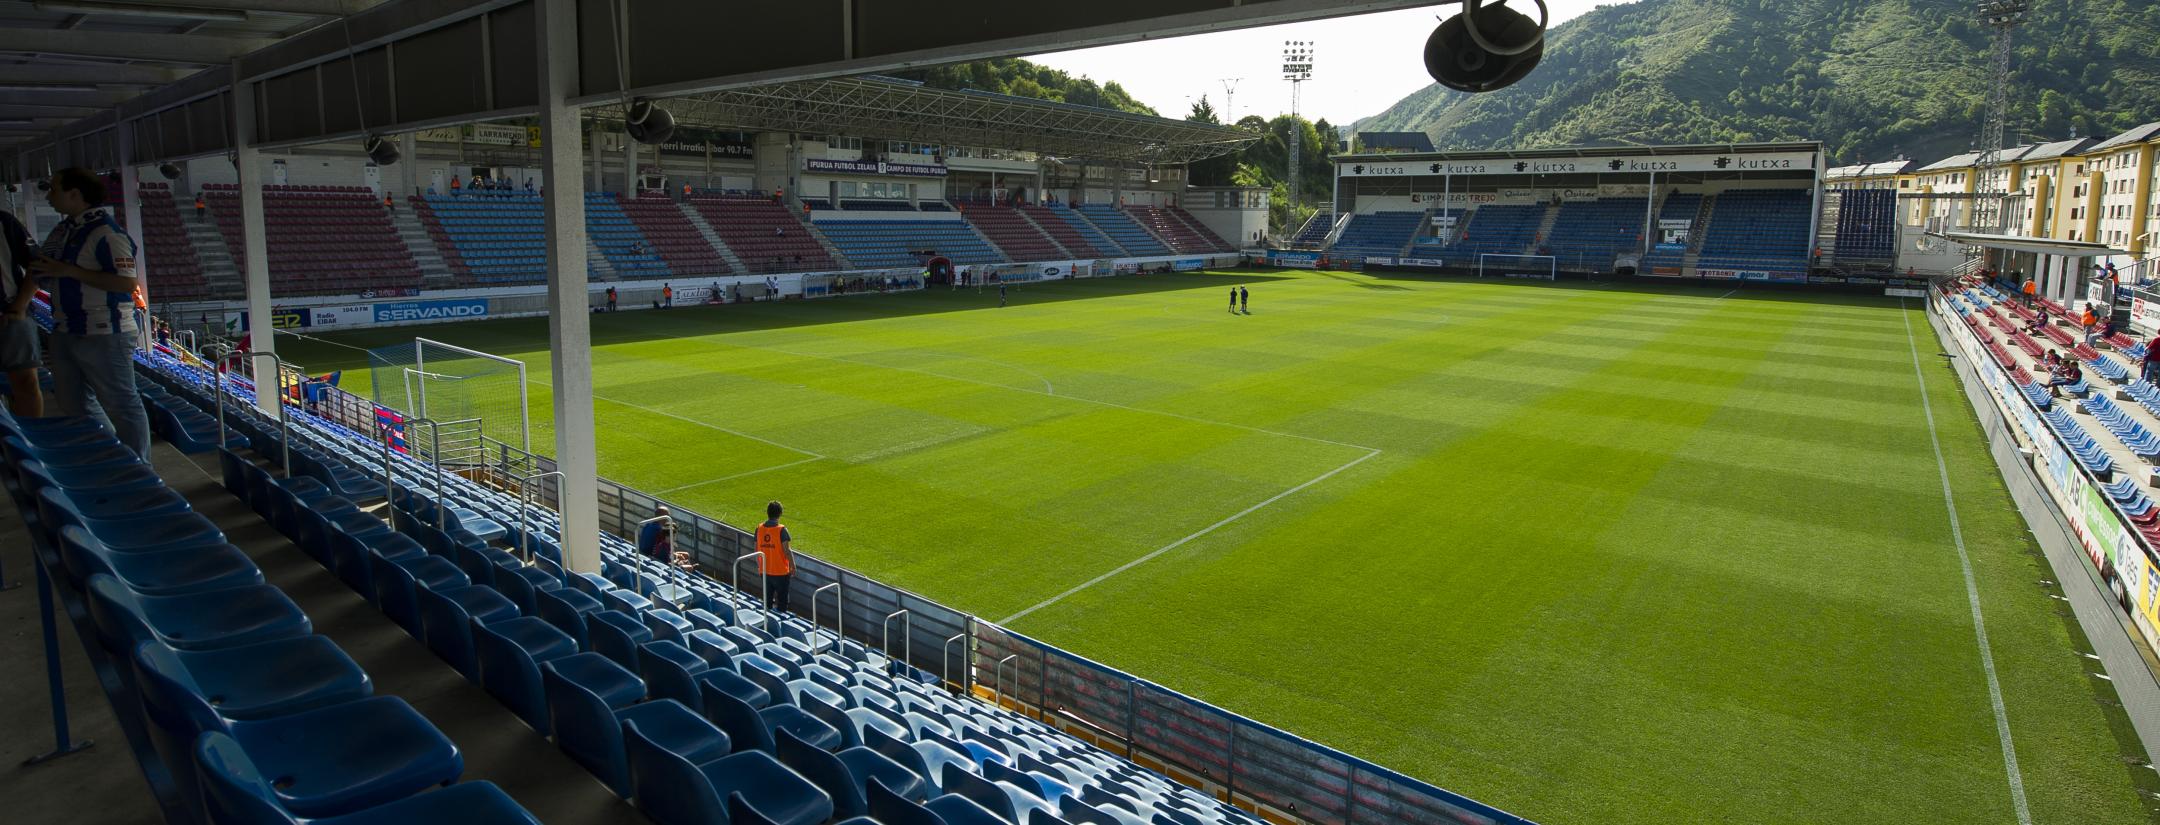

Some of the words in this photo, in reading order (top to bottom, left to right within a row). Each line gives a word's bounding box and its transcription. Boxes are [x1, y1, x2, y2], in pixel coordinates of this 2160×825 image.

[810, 161, 833, 169] IPURUA
[834, 162, 856, 170] FUTBOL
[1533, 161, 1575, 172] kutxa
[1630, 159, 1678, 170] kutxa
[1738, 156, 1791, 168] kutxa
[886, 165, 905, 173] CAMPO
[912, 166, 929, 174] FUTBOL
[1369, 165, 1404, 175] kutxa
[1447, 163, 1486, 173] kutxa
[1422, 193, 1466, 201] LIMPIZAS
[1469, 194, 1496, 202] TREJO
[378, 304, 485, 321] SERVANDO
[272, 313, 302, 329] ER
